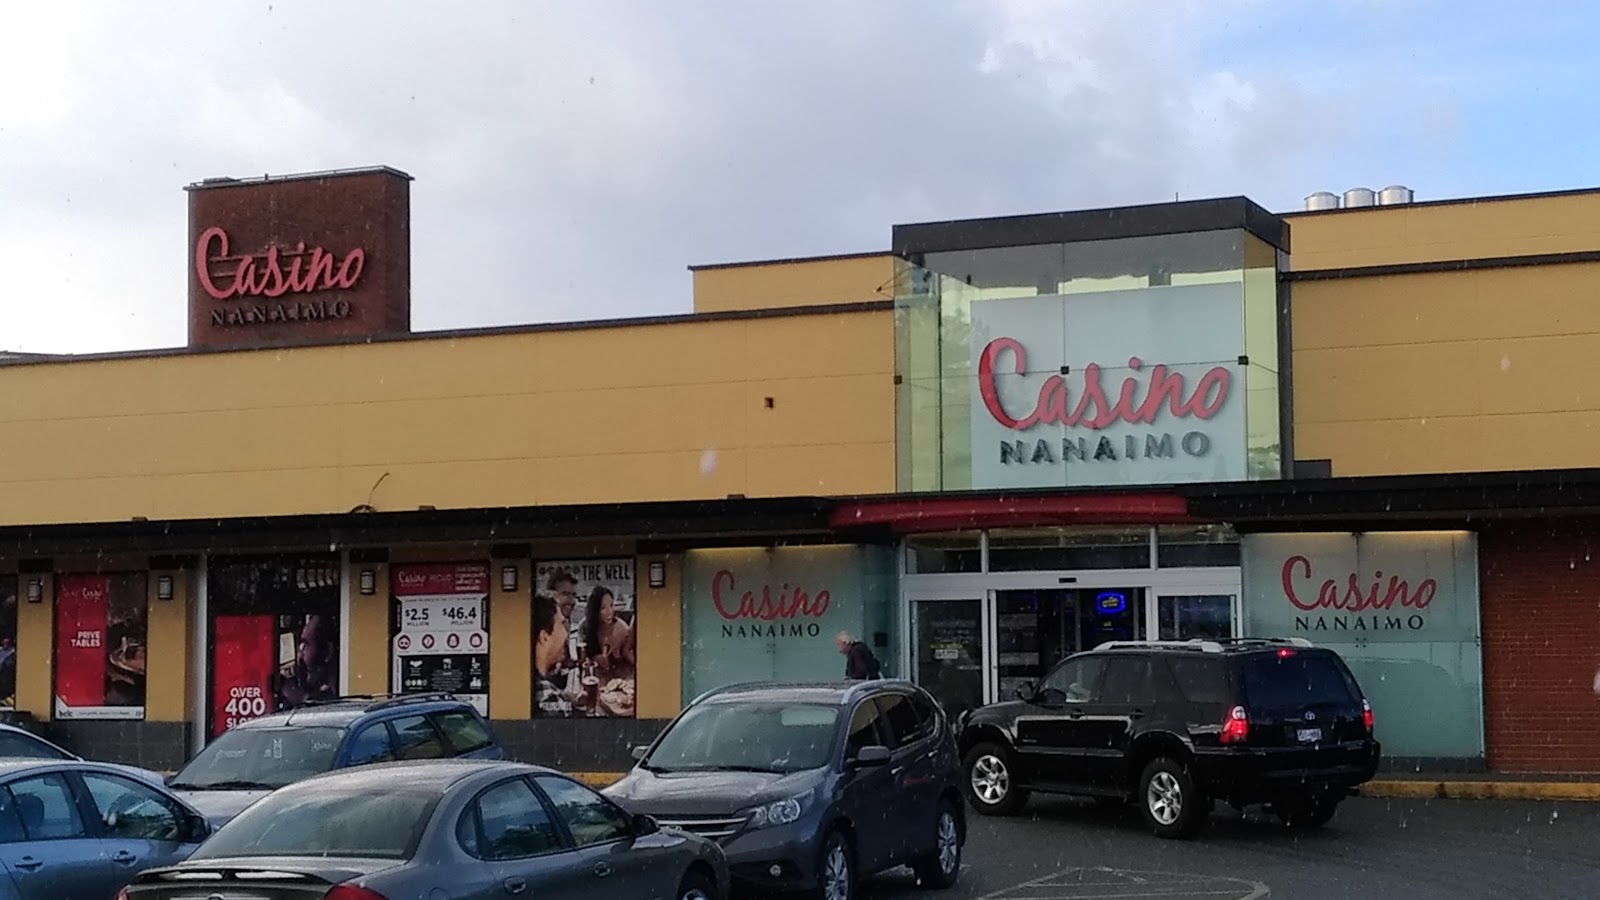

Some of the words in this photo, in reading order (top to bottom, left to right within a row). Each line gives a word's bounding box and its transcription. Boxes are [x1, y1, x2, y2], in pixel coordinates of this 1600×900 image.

[196, 227, 365, 299] Casino
[211, 301, 351, 326] NANAIMO
[978, 337, 1230, 430] Casino
[1000, 431, 1210, 464] NANAIMO
[582, 565, 602, 581] THE
[605, 563, 631, 580] WELL
[1282, 555, 1437, 612] Casino
[712, 570, 830, 620] Casino
[405, 608, 429, 620] $2.5
[442, 606, 477, 619] $46.4
[722, 623, 820, 639] NANAIMO
[1296, 615, 1424, 631] NANAIMO
[71, 638, 101, 647] TABLES
[229, 687, 261, 698] OVER
[225, 697, 265, 716] 400
